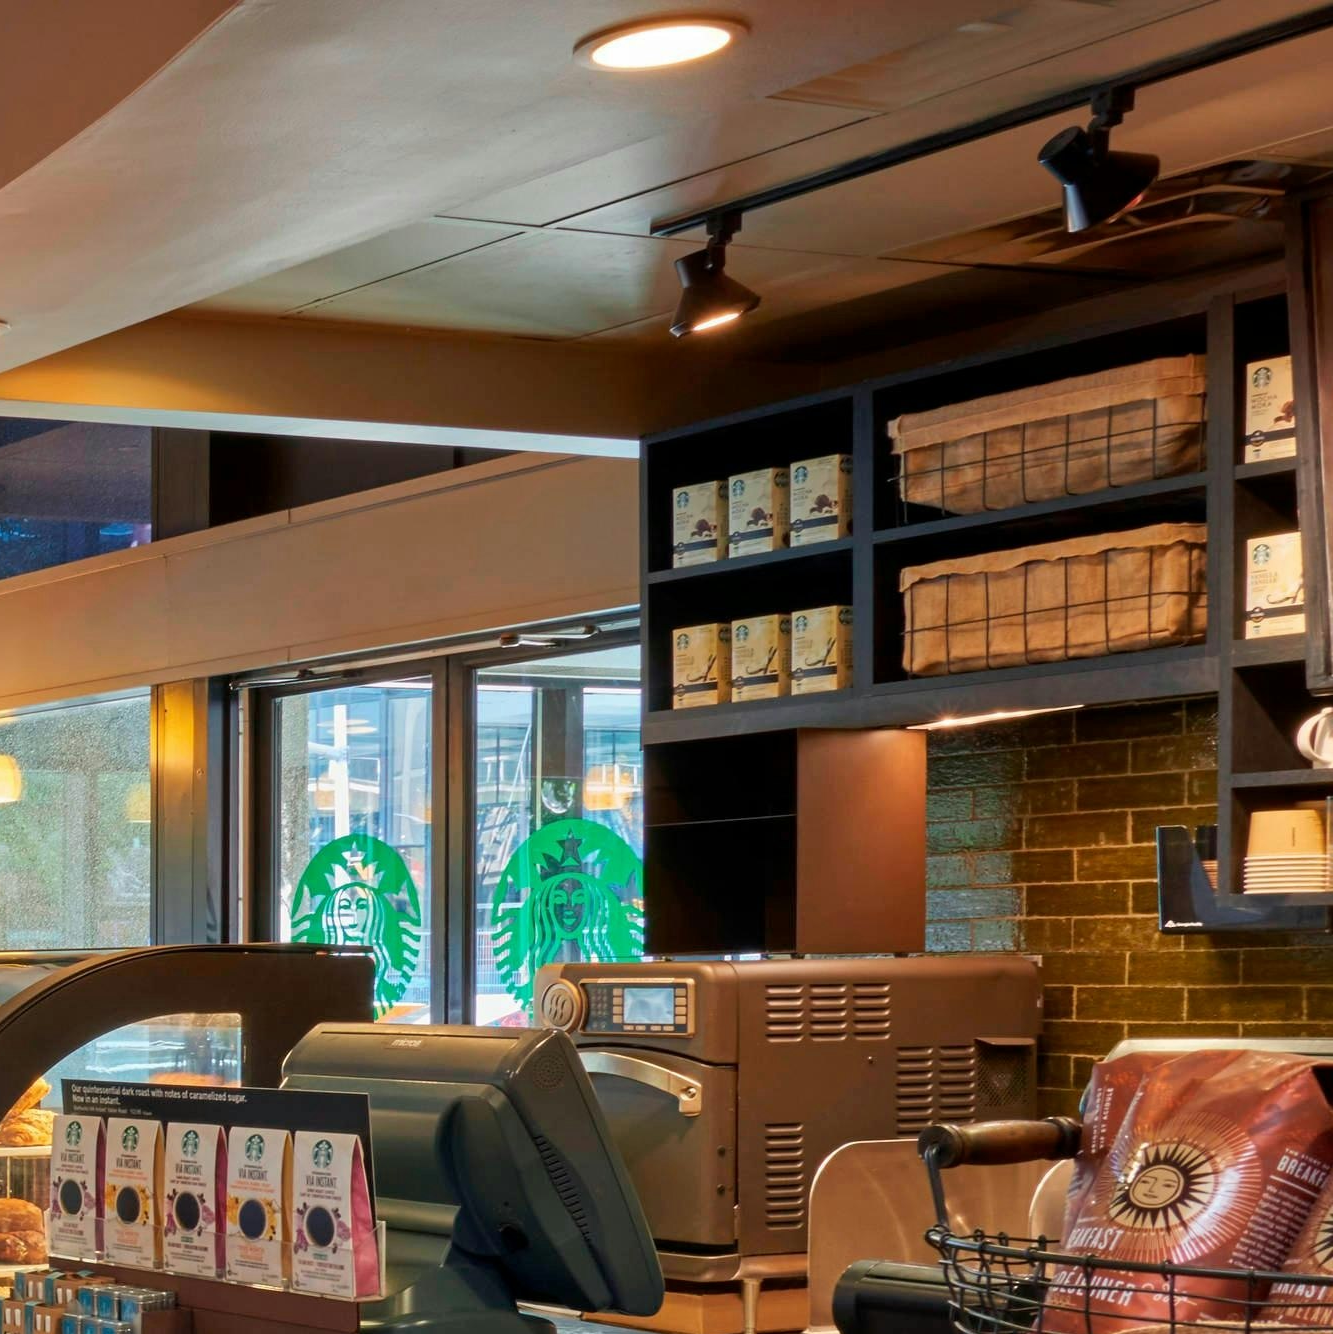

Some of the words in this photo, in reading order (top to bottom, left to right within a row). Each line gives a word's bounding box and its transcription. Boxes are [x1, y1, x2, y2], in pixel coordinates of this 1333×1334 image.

[71, 1083, 82, 1093] Our
[83, 1085, 121, 1097] quintessential
[121, 1087, 135, 1096] dark
[135, 1088, 151, 1097] roast
[151, 1089, 164, 1098] with
[164, 1090, 181, 1099] notes
[182, 1091, 189, 1099] of
[189, 1092, 227, 1102] caramelized
[227, 1094, 247, 1104] sugar.
[72, 1094, 83, 1103] Now
[1276, 1154, 1328, 1189] BREAKF
[305, 1175, 315, 1187] VIA
[315, 1176, 337, 1189] INSTANT
